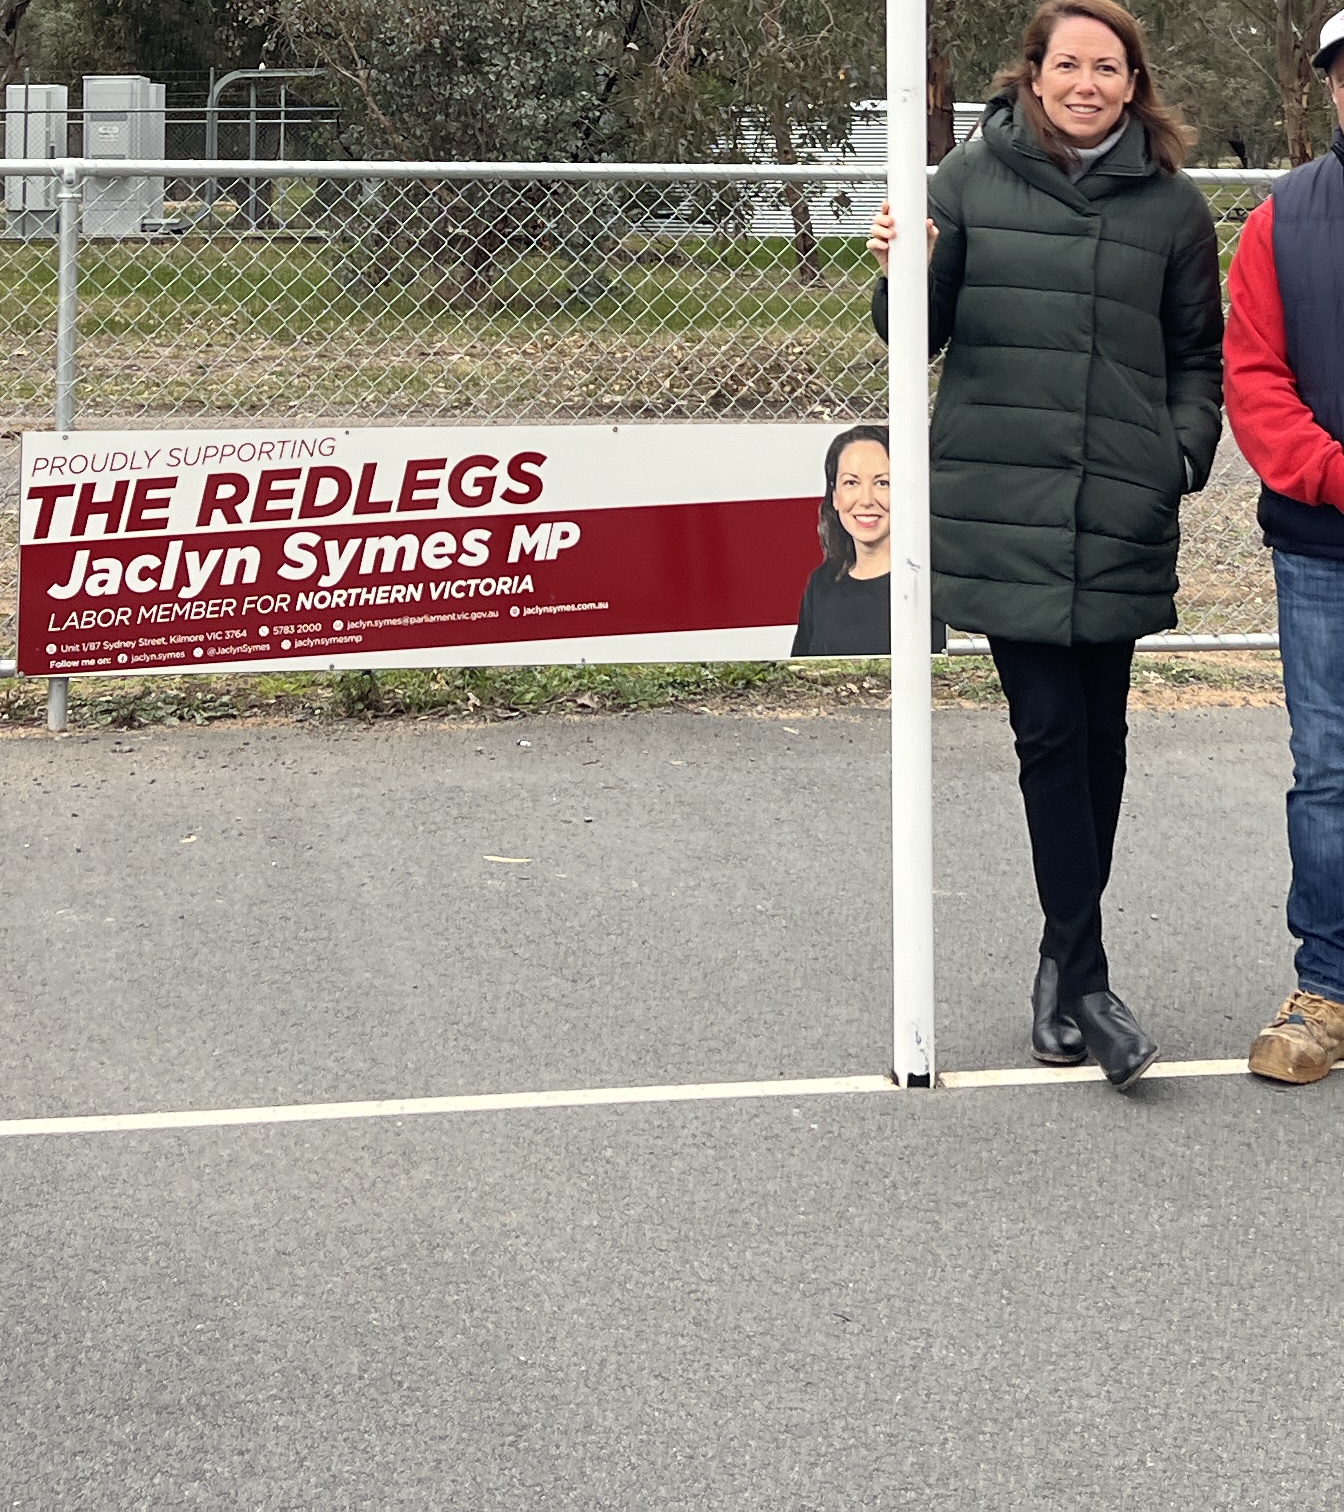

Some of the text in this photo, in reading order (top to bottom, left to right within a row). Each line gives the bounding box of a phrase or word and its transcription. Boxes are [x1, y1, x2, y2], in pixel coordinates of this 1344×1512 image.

[31, 438, 336, 477] PROUDLY SUPPORTING
[27, 452, 547, 539] THE REDLEGS
[47, 521, 580, 600] Jaclyn Symes MP
[48, 575, 534, 632] LABOR MEMBER FOR NORTHERN VICTORIA
[61, 644, 80, 653] Unit
[82, 642, 100, 651] 1/87
[103, 639, 136, 651] Sydney
[138, 637, 168, 647] Street,
[170, 633, 204, 643] Kilmore
[206, 632, 223, 640] VIC
[225, 630, 247, 639] 3764
[273, 625, 295, 635] 5783
[297, 623, 321, 633] 2000
[523, 601, 608, 616] jaclynsymes.com.au
[50, 659, 79, 669] Follow
[97, 657, 111, 666] on:
[207, 643, 270, 657] @JaclynSymes
[294, 634, 362, 648] jaclynsymesmp
